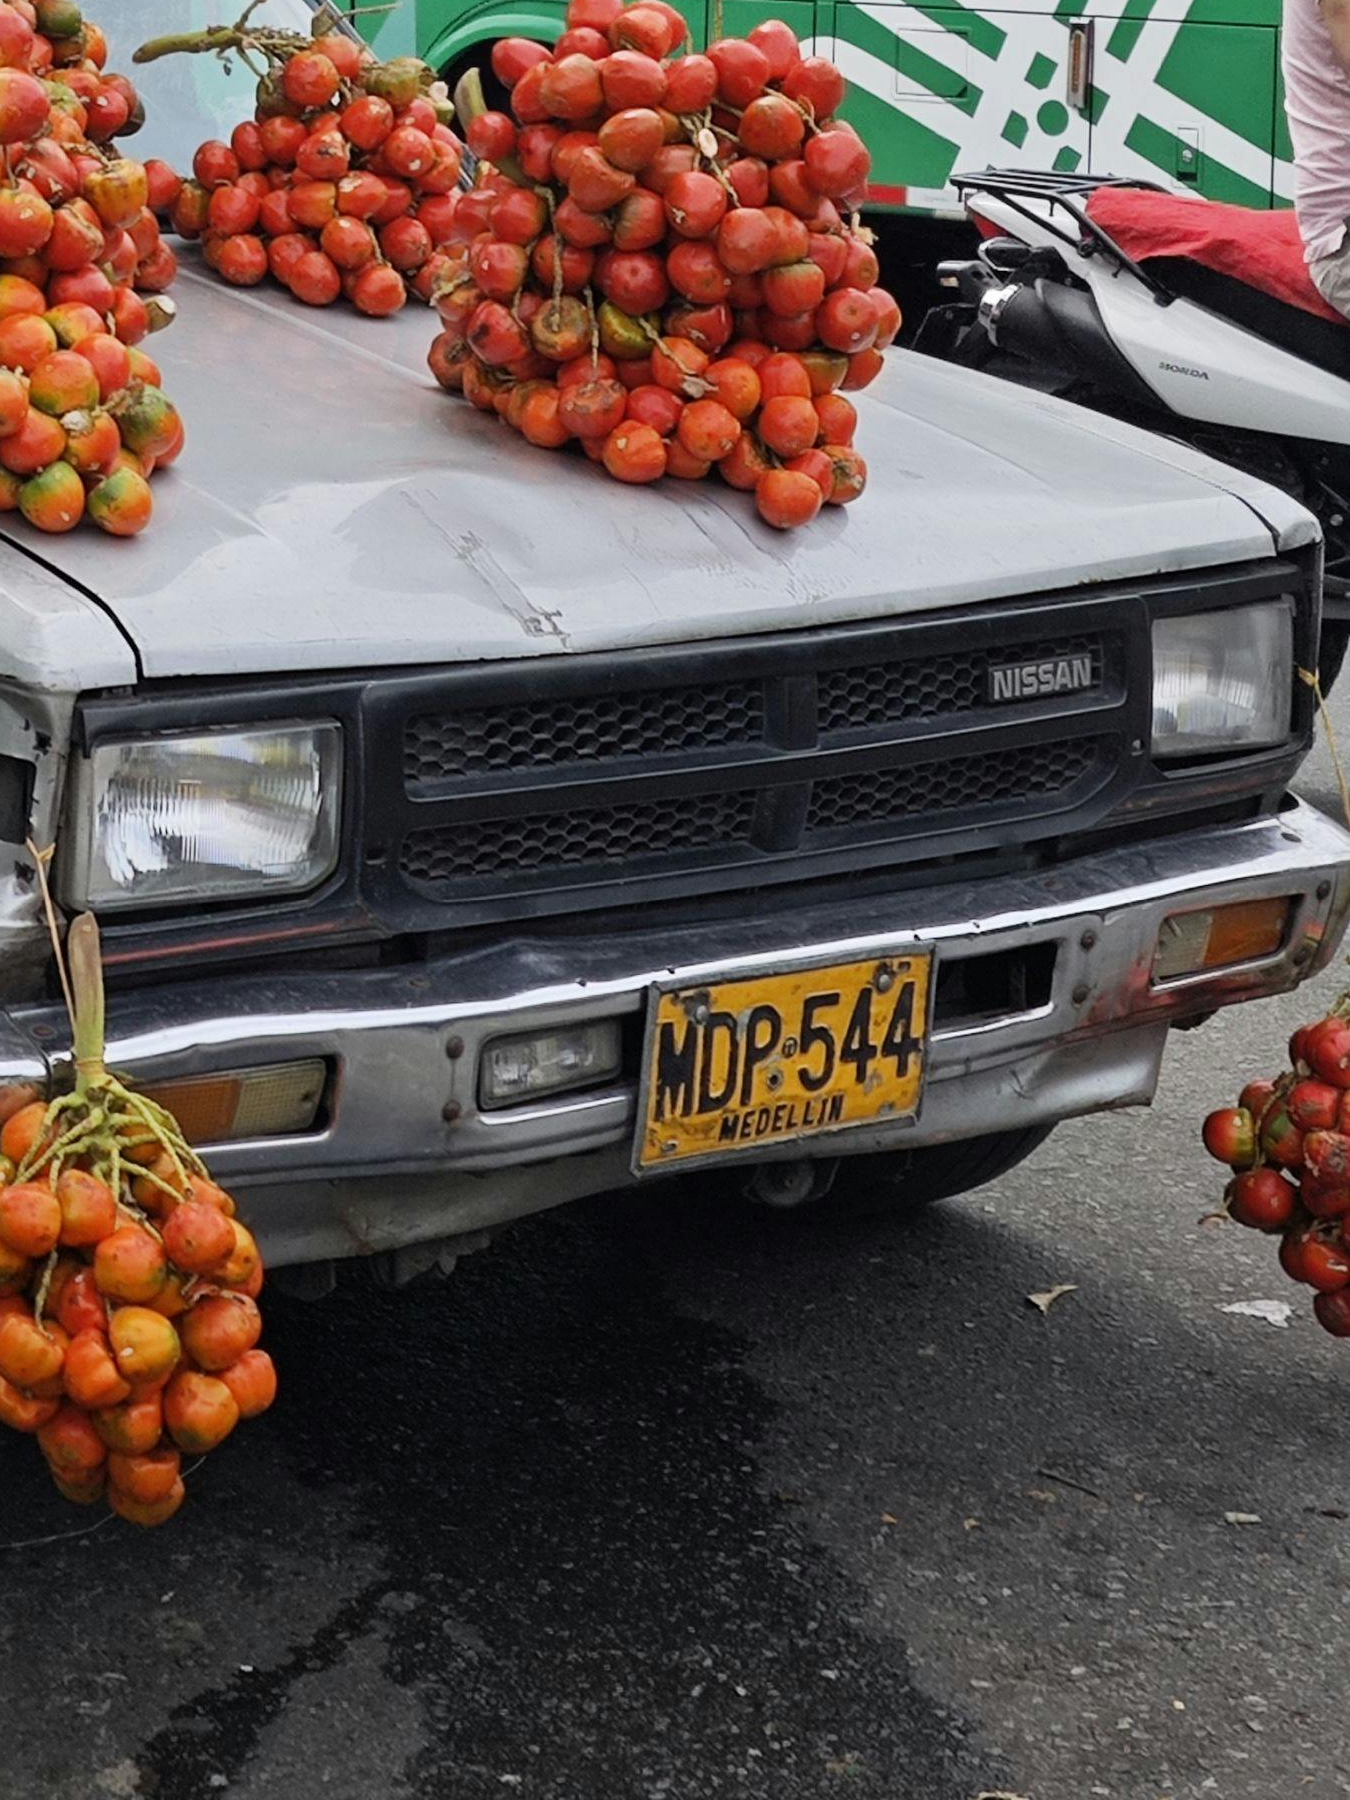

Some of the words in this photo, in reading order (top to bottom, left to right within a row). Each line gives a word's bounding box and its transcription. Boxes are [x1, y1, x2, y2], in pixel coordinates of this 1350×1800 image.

[1159, 361, 1210, 381] HONDA
[993, 658, 1091, 700] NISSAN
[654, 1004, 782, 1122] MDP
[797, 981, 922, 1092] 544
[718, 1094, 844, 1143] MEDELLIN
